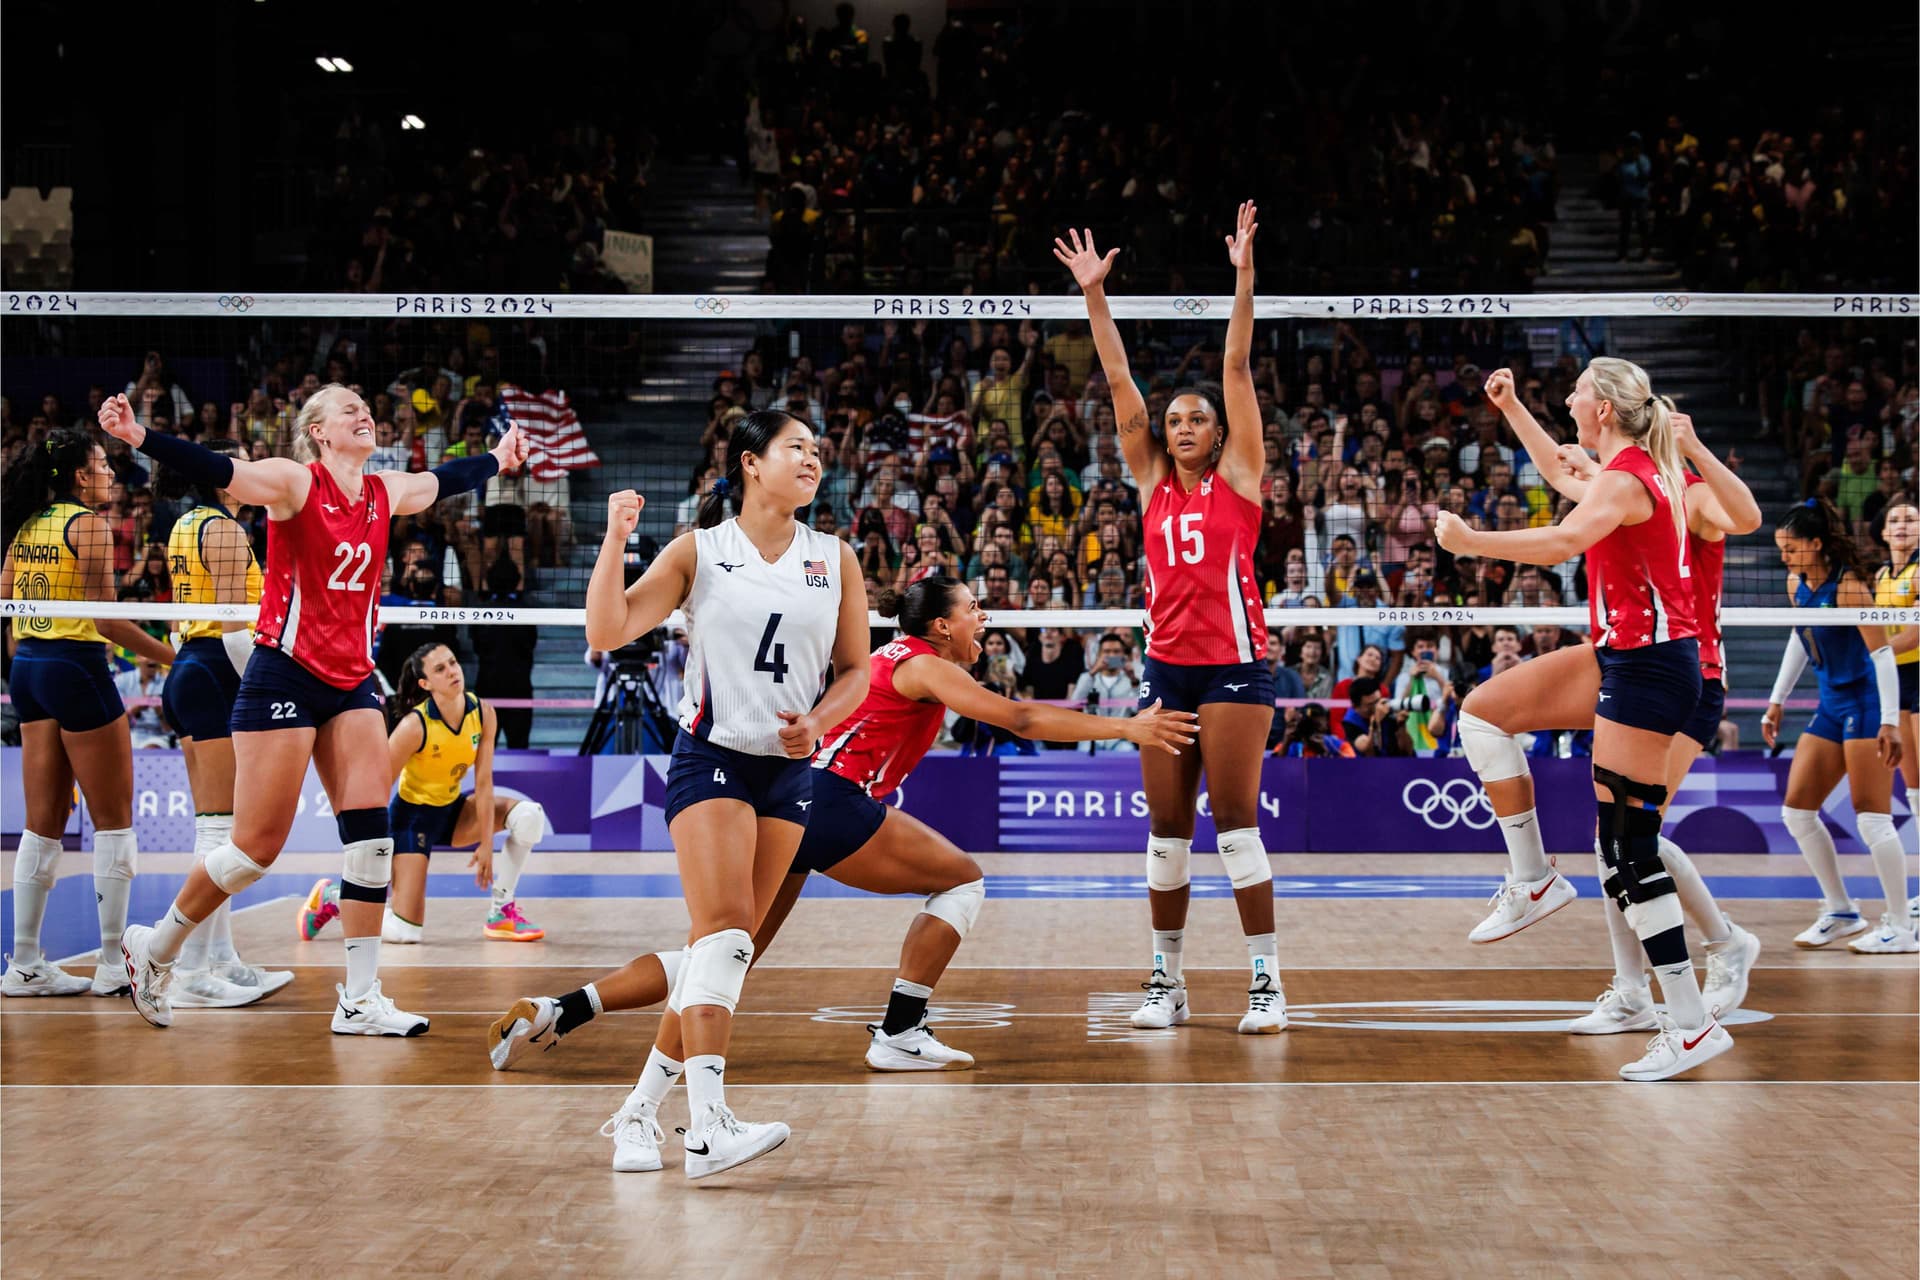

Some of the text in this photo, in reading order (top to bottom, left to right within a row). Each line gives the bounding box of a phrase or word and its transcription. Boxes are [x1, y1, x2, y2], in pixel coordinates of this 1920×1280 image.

[1161, 513, 1205, 566] 15
[327, 541, 372, 591] 22
[805, 574, 830, 589] USA
[754, 613, 788, 684] 4
[270, 701, 298, 720] 22
[713, 768, 727, 785] 4
